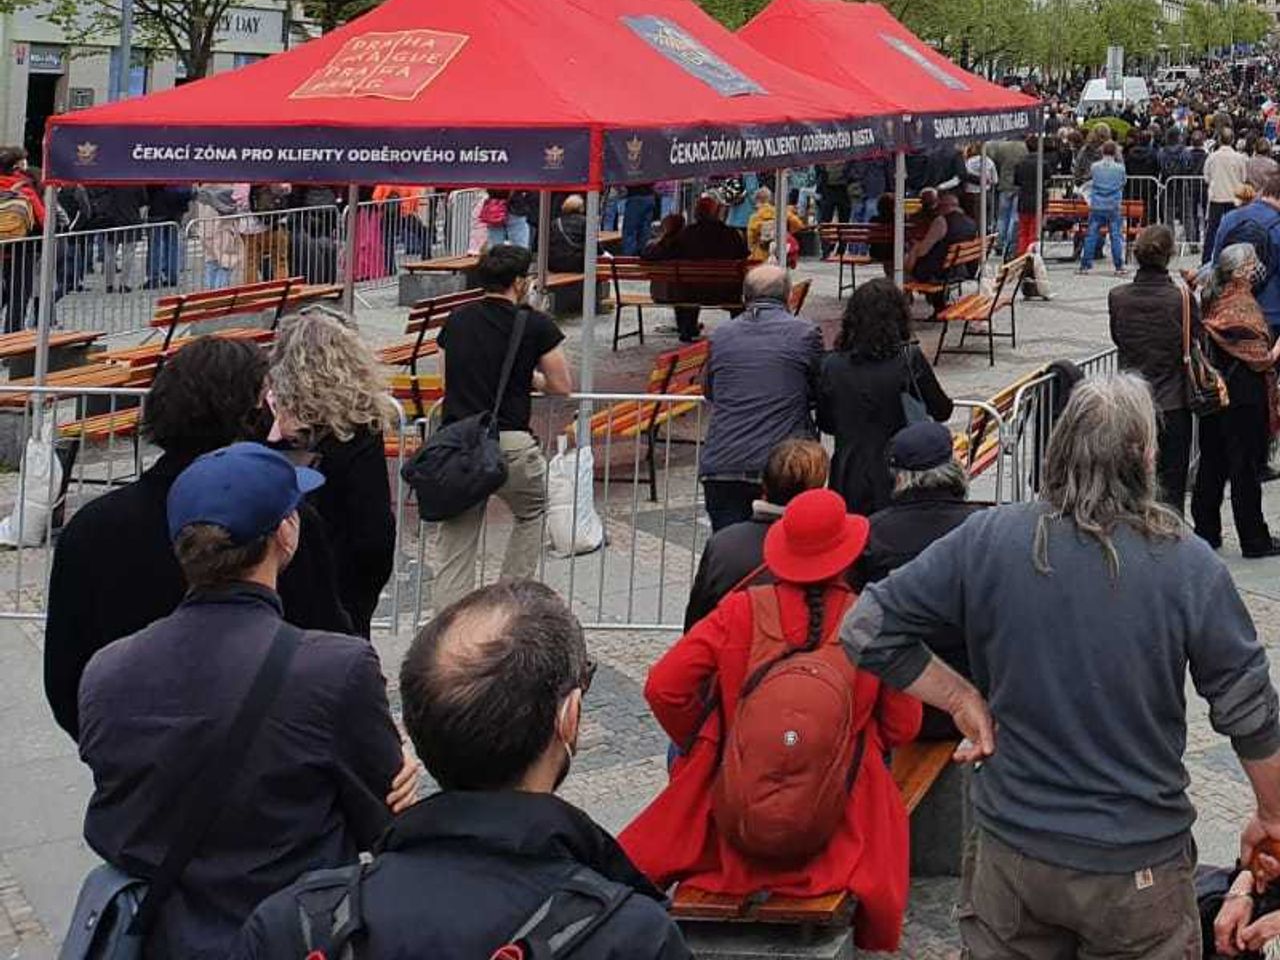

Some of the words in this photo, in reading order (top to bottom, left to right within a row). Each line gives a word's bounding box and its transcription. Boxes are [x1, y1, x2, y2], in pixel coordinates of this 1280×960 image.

[132, 143, 190, 160] ČEKACÍ
[193, 144, 238, 161] ZÓNA
[242, 148, 274, 161] PRO
[278, 149, 344, 161] KLIENTY
[348, 145, 456, 162] ODBĚROVÉHO
[460, 145, 508, 162] MÍSTA
[669, 135, 710, 164] ČEKACÍ
[711, 134, 742, 161] ZÓNA
[744, 139, 765, 159] PRO
